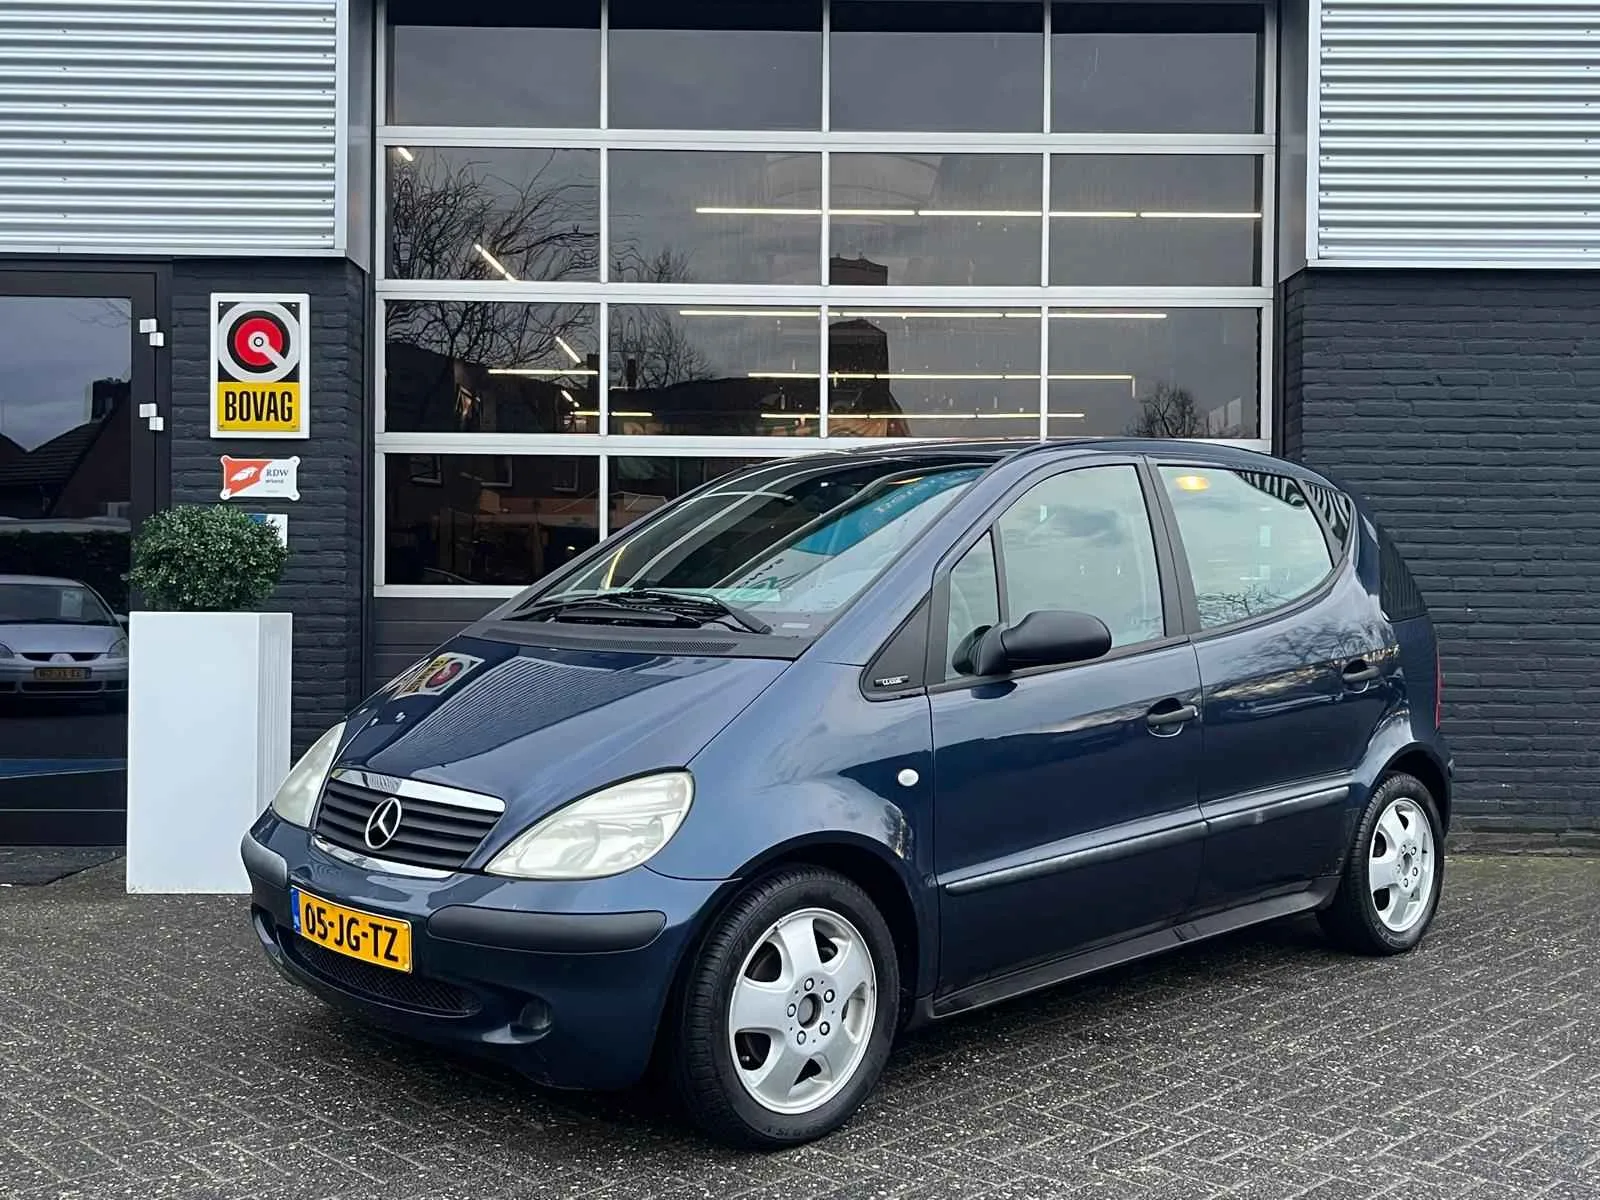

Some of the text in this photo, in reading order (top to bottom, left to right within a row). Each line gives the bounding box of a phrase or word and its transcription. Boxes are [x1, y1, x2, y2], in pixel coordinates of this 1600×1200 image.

[224, 391, 293, 422] BOVAG
[266, 468, 289, 477] RDW
[304, 902, 399, 963] 05-JG-TZ
